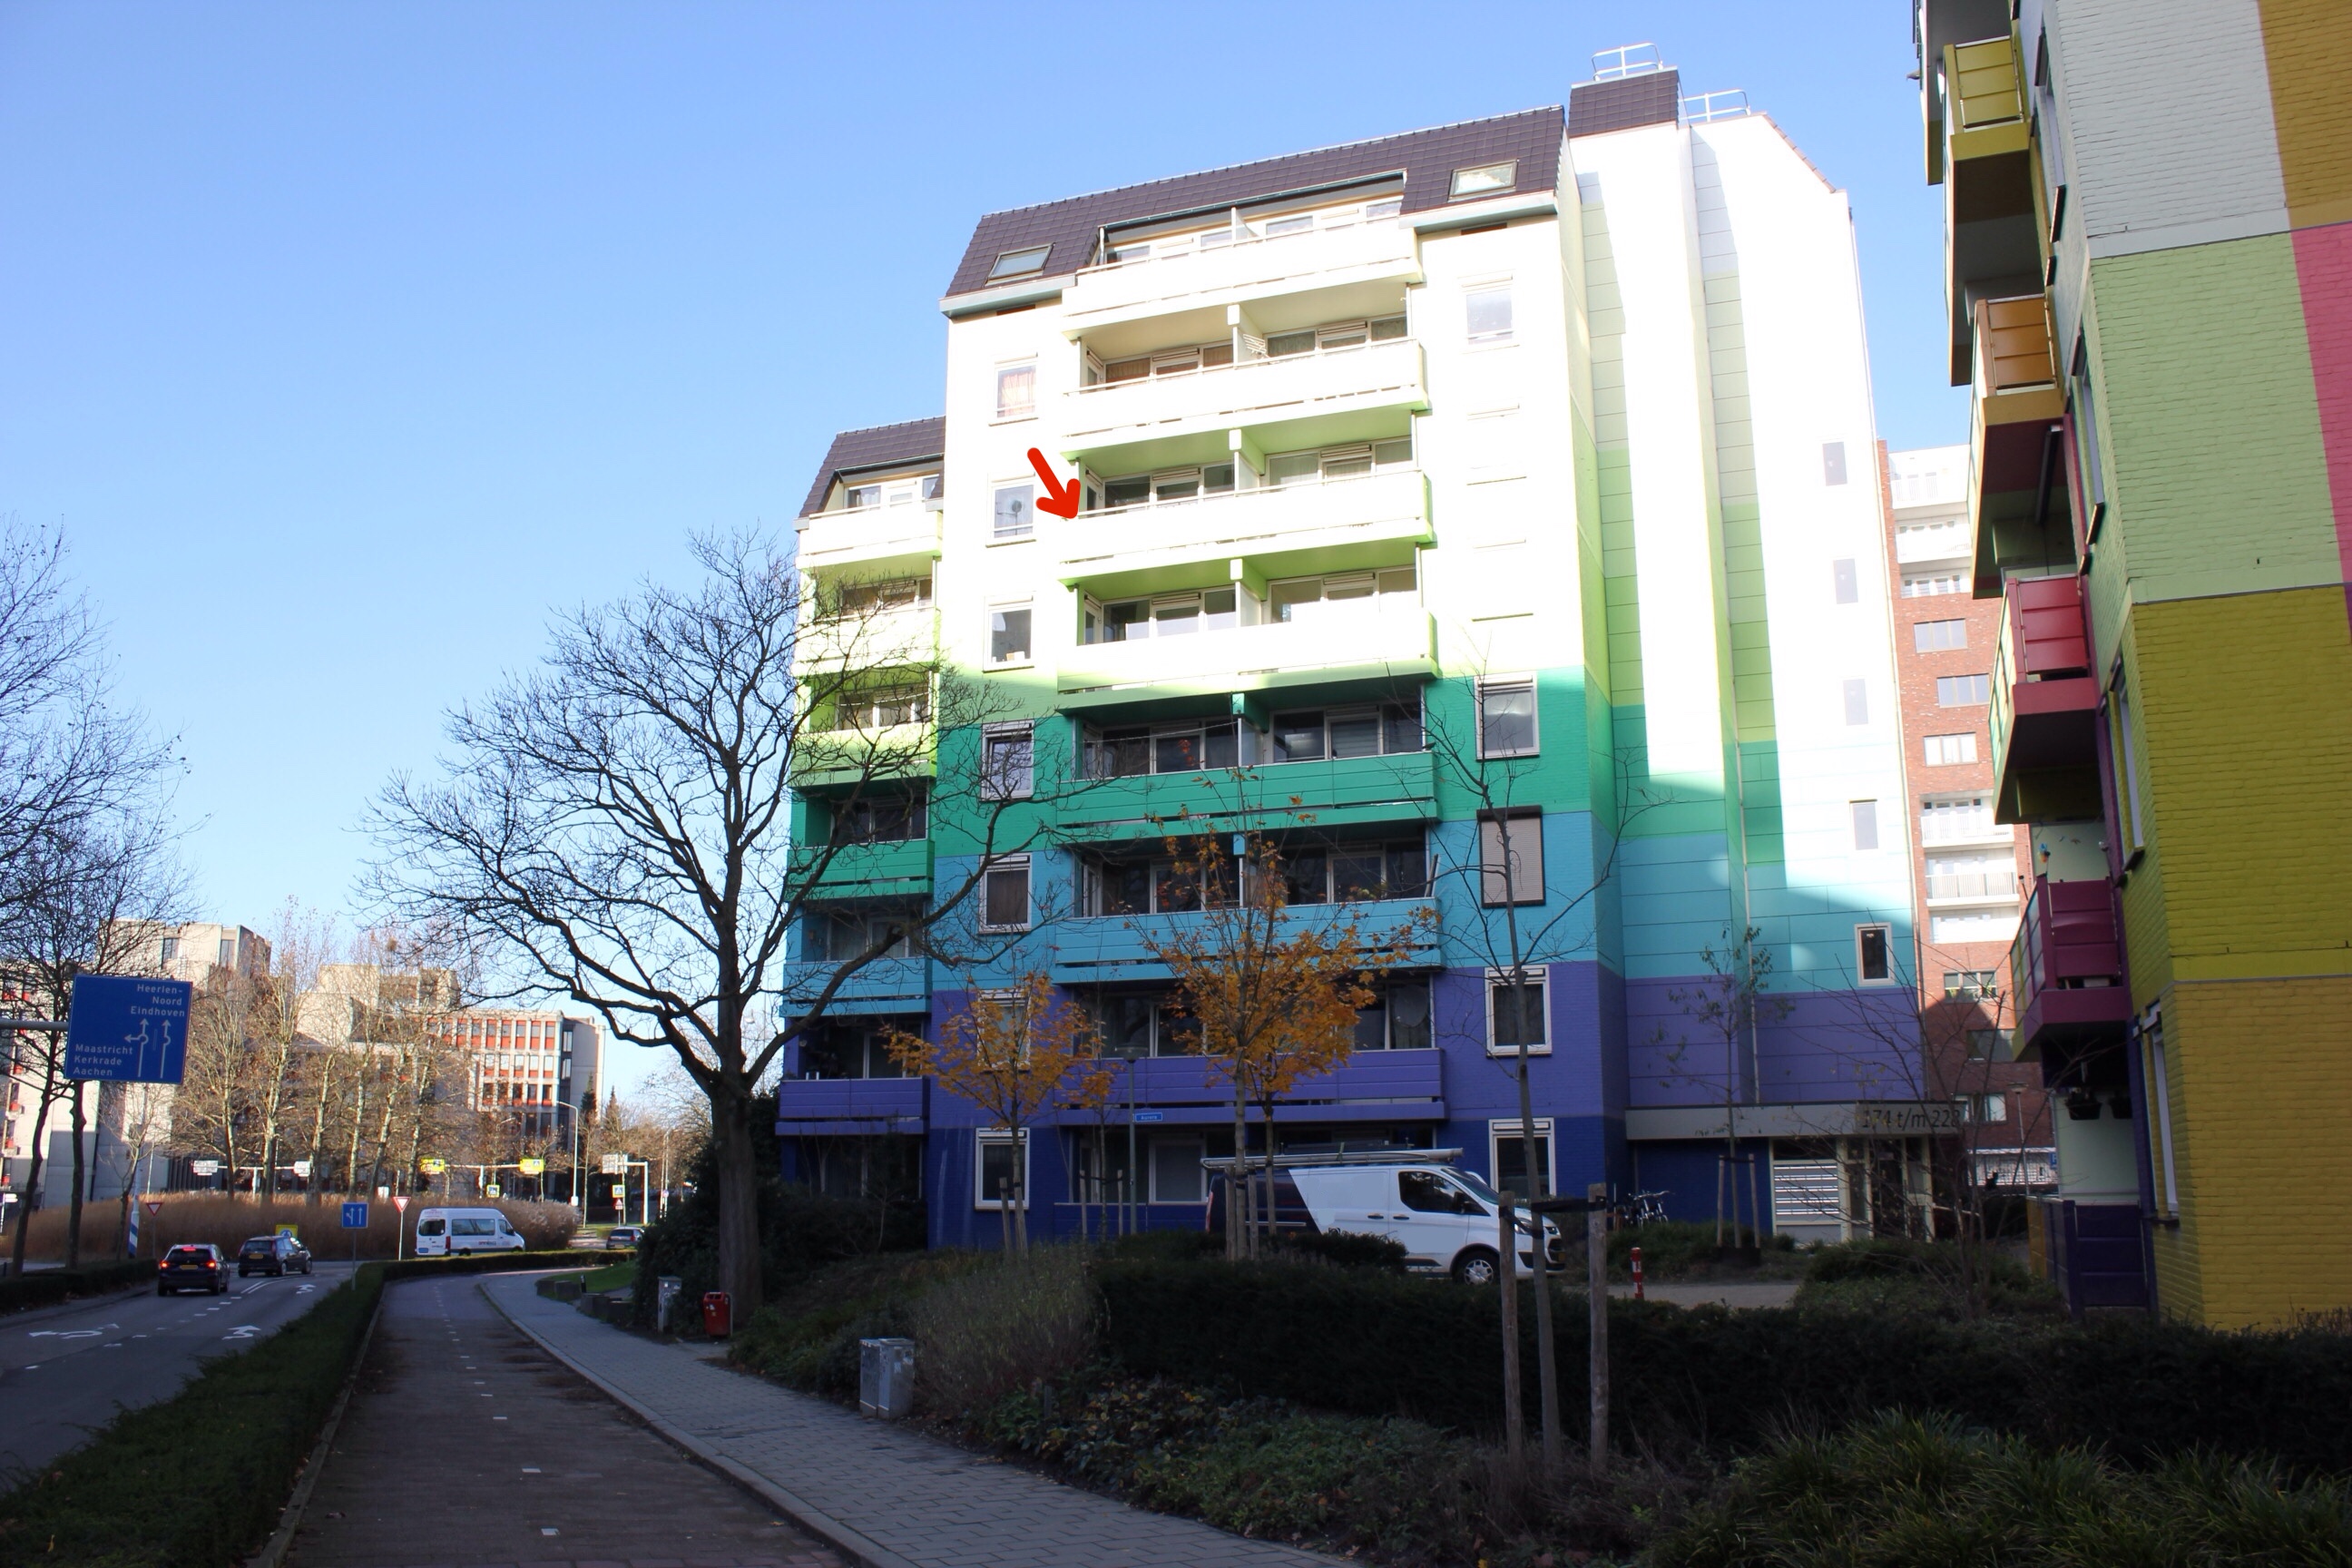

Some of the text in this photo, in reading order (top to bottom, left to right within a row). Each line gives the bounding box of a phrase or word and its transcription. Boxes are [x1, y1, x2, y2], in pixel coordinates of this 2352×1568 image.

[137, 984, 182, 994] Heerlen-
[152, 996, 182, 1005] Noord
[131, 1005, 185, 1017] Eindhoven
[75, 1044, 133, 1055] Maastricht
[74, 1055, 122, 1065] Kerkrade
[73, 1066, 113, 1077] Aachen
[1862, 1110, 1891, 1128] 174
[1897, 1108, 1926, 1132] t/m
